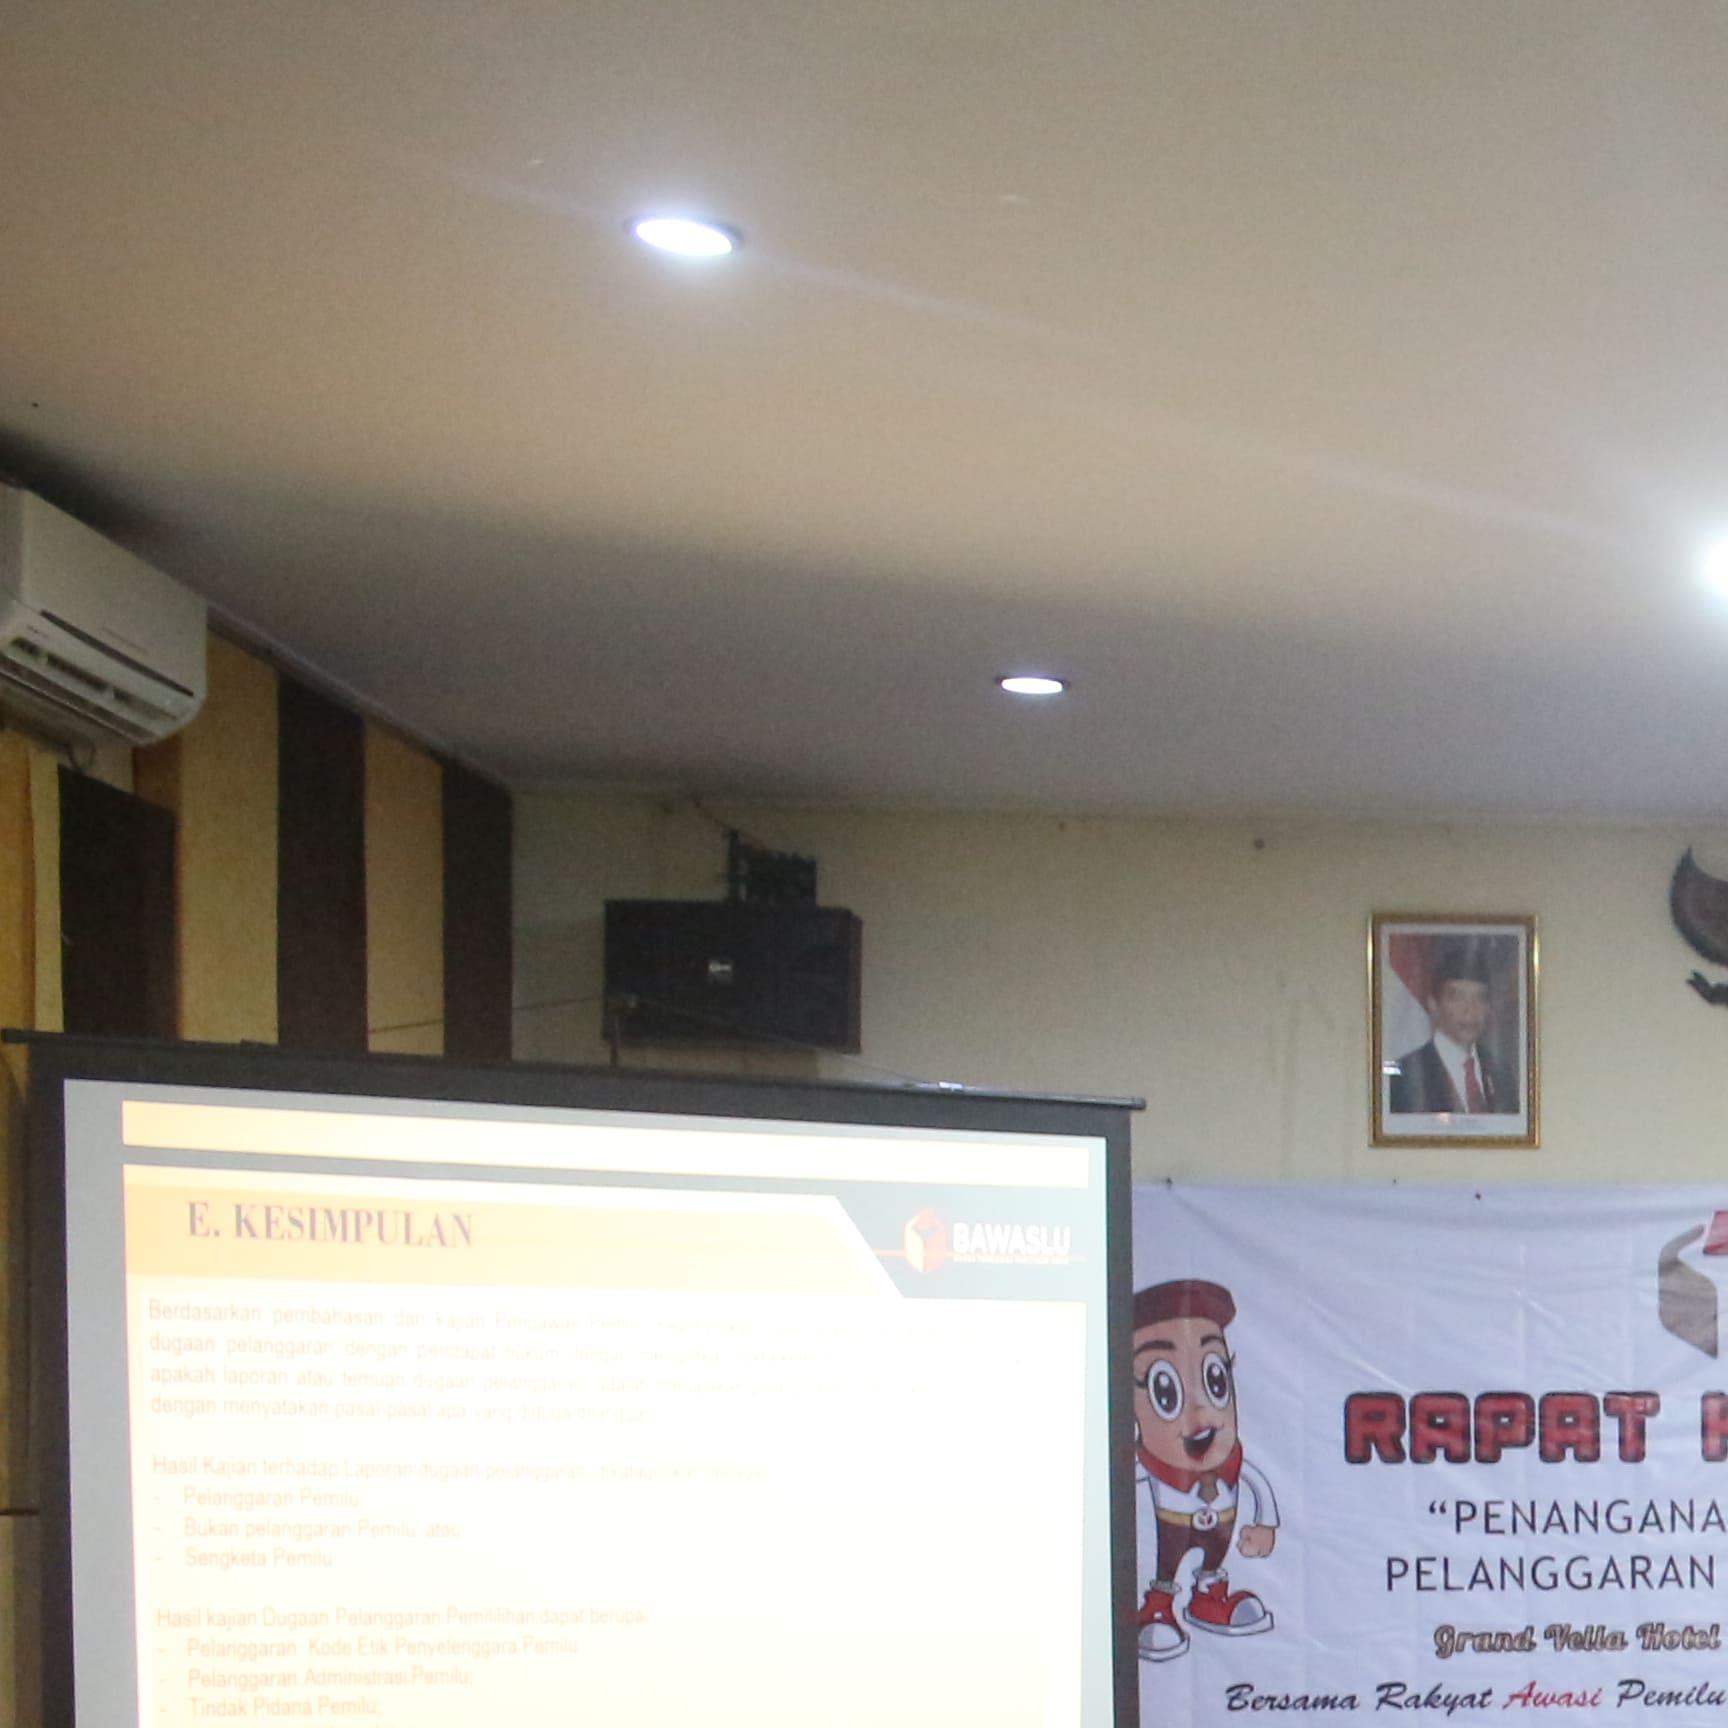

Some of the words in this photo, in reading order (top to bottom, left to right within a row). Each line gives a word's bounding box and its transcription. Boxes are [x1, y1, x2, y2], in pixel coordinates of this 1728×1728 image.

[187, 1201, 221, 1238] E.
[234, 1204, 474, 1248] KESIMPULAN
[953, 1222, 1071, 1256] BAWASLU
[148, 1298, 263, 1324] Berdasarkan
[149, 1334, 215, 1360] dugaan
[225, 1336, 334, 1362] pelanggaran
[150, 1366, 215, 1391] apakah
[224, 1366, 288, 1390] laporan
[151, 1396, 216, 1419] dengan
[224, 1397, 329, 1420] menyatakan
[1344, 1390, 1660, 1465] RAPAT
[153, 1456, 198, 1475] Hasil
[203, 1457, 256, 1478] Kajian
[263, 1457, 339, 1480] terhadap
[344, 1458, 413, 1480] Laporan
[183, 1486, 294, 1510] Pelanggaran
[183, 1516, 241, 1538] Bukan
[245, 1519, 351, 1541] pelanggaran
[184, 1546, 268, 1570] Sengketa
[1386, 1553, 1715, 1592] PELANGGARAN
[157, 1606, 203, 1627] Hasil
[207, 1606, 257, 1629] kajian
[263, 1606, 329, 1629] Dugaan
[335, 1606, 442, 1629] Pelanggaran
[187, 1638, 297, 1661] Pelanggaran
[308, 1637, 353, 1657] Kode
[357, 1637, 388, 1657] Etik
[394, 1636, 518, 1660] Penyelenggara
[1433, 1623, 1537, 1659] Grand
[1543, 1623, 1628, 1652] Vella
[1635, 1622, 1720, 1652] Hotel
[187, 1668, 298, 1690] Pelanggaran
[303, 1667, 409, 1687] Administrasi
[190, 1696, 249, 1717] Tindak
[252, 1696, 313, 1717] Pidana
[1225, 1682, 1360, 1713] Bersama
[1374, 1681, 1493, 1717] Rakyat
[1502, 1680, 1603, 1710] Awasi
